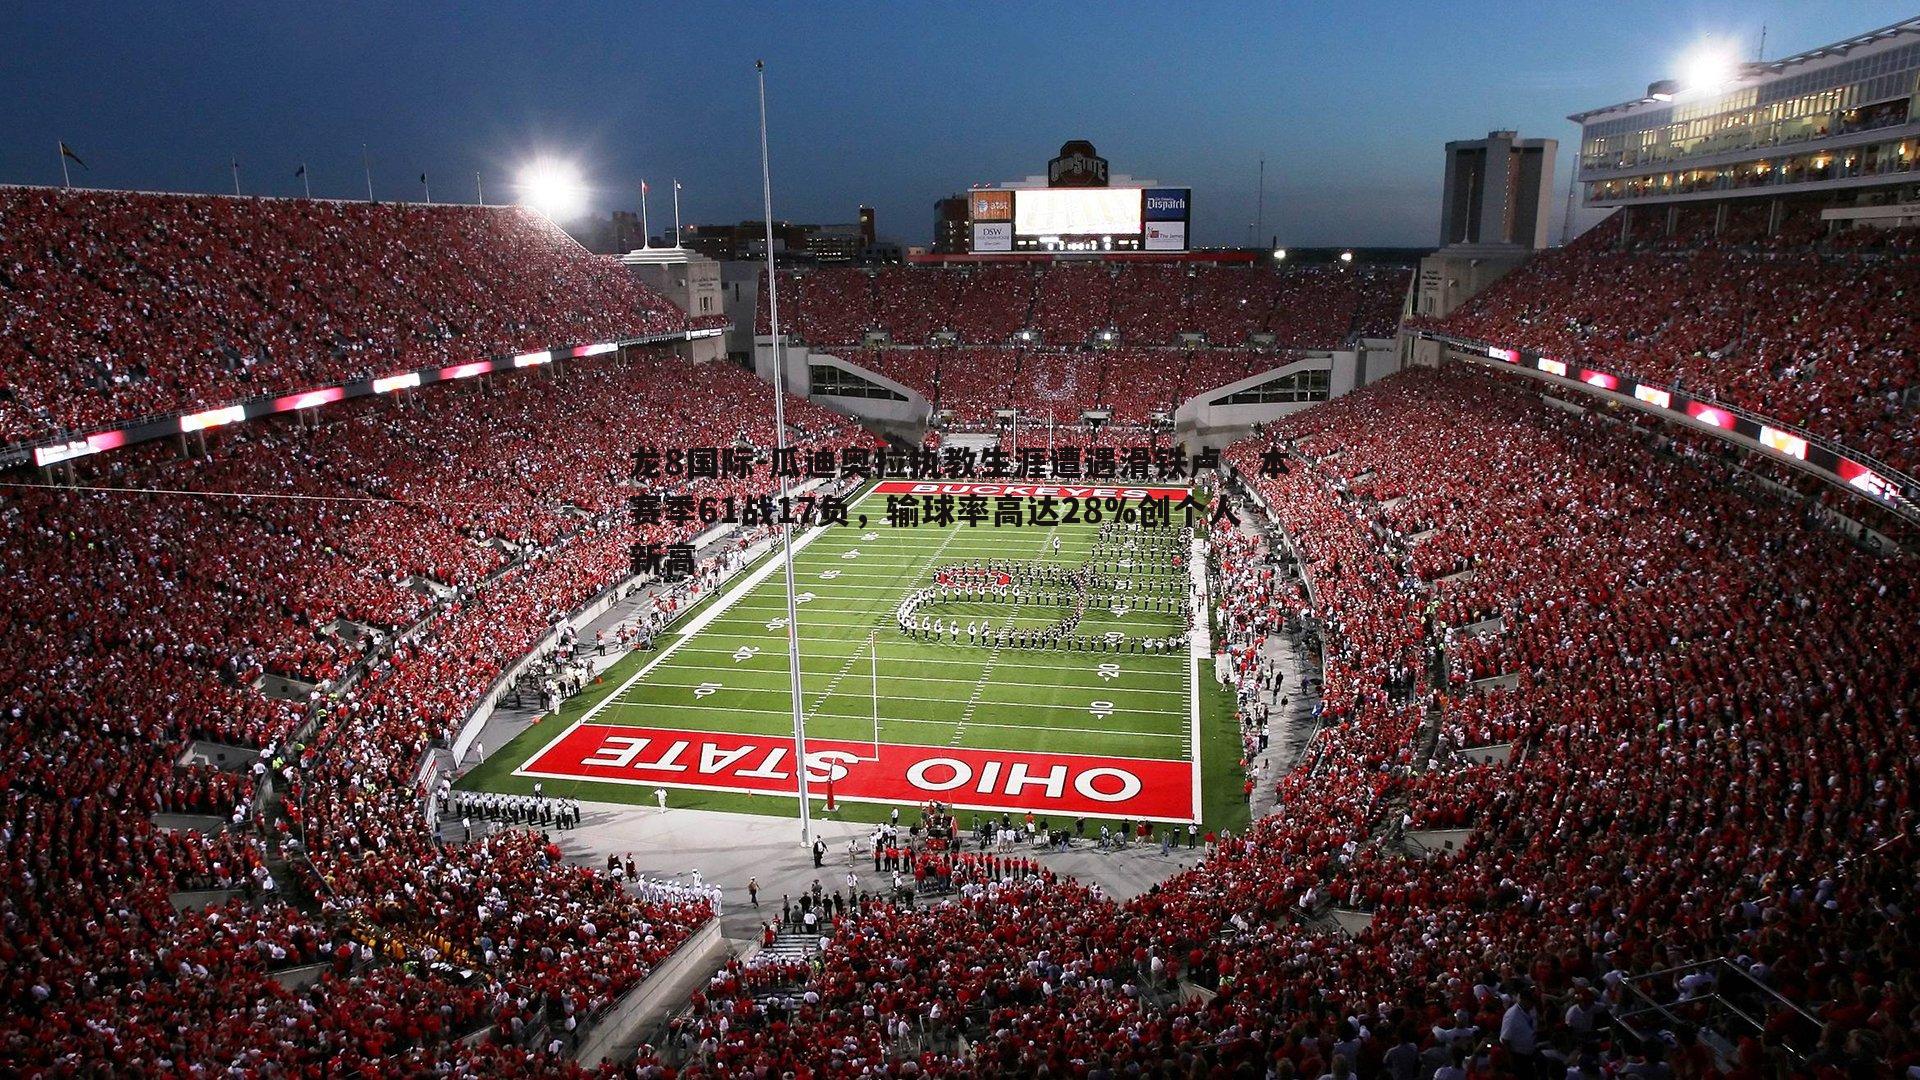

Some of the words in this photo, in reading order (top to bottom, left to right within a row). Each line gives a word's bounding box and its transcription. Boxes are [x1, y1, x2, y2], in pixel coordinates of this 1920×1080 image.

[1147, 197, 1185, 210] Dispatch
[983, 228, 1002, 236] DSW
[911, 483, 1149, 498] BUCKEYES
[733, 646, 760, 659] 20
[1097, 663, 1120, 678] 20
[694, 682, 723, 697] 10
[1089, 701, 1114, 715] 10
[580, 736, 859, 783] STATE
[906, 757, 1143, 802] OHIO
